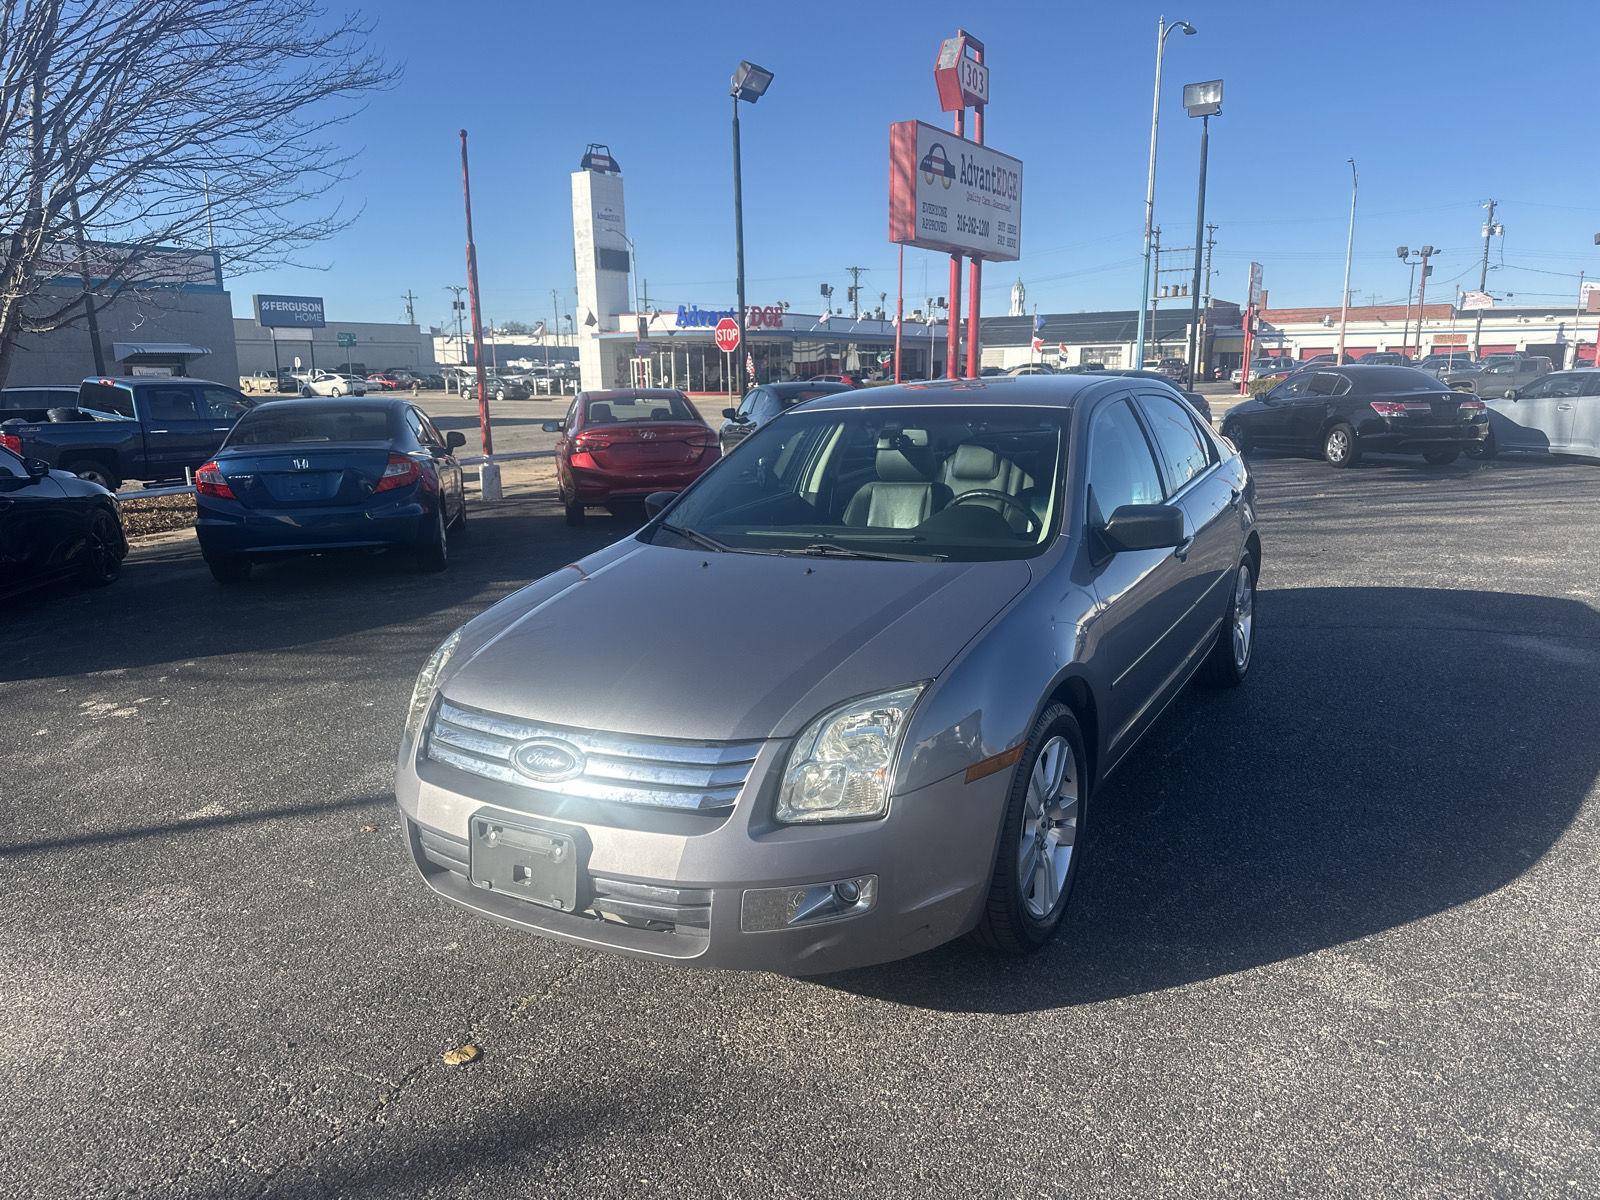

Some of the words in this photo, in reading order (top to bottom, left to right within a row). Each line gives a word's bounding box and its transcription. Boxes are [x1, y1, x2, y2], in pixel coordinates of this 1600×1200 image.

[961, 60, 984, 94] 1303
[960, 153, 1018, 201] AdvantEDGE
[922, 202, 948, 218] EVERYONE
[922, 217, 948, 233] APPROVED
[270, 301, 322, 312] FERGUSON
[295, 312, 323, 322] HOME
[716, 328, 738, 342] STOP
[526, 748, 568, 769] Ford
